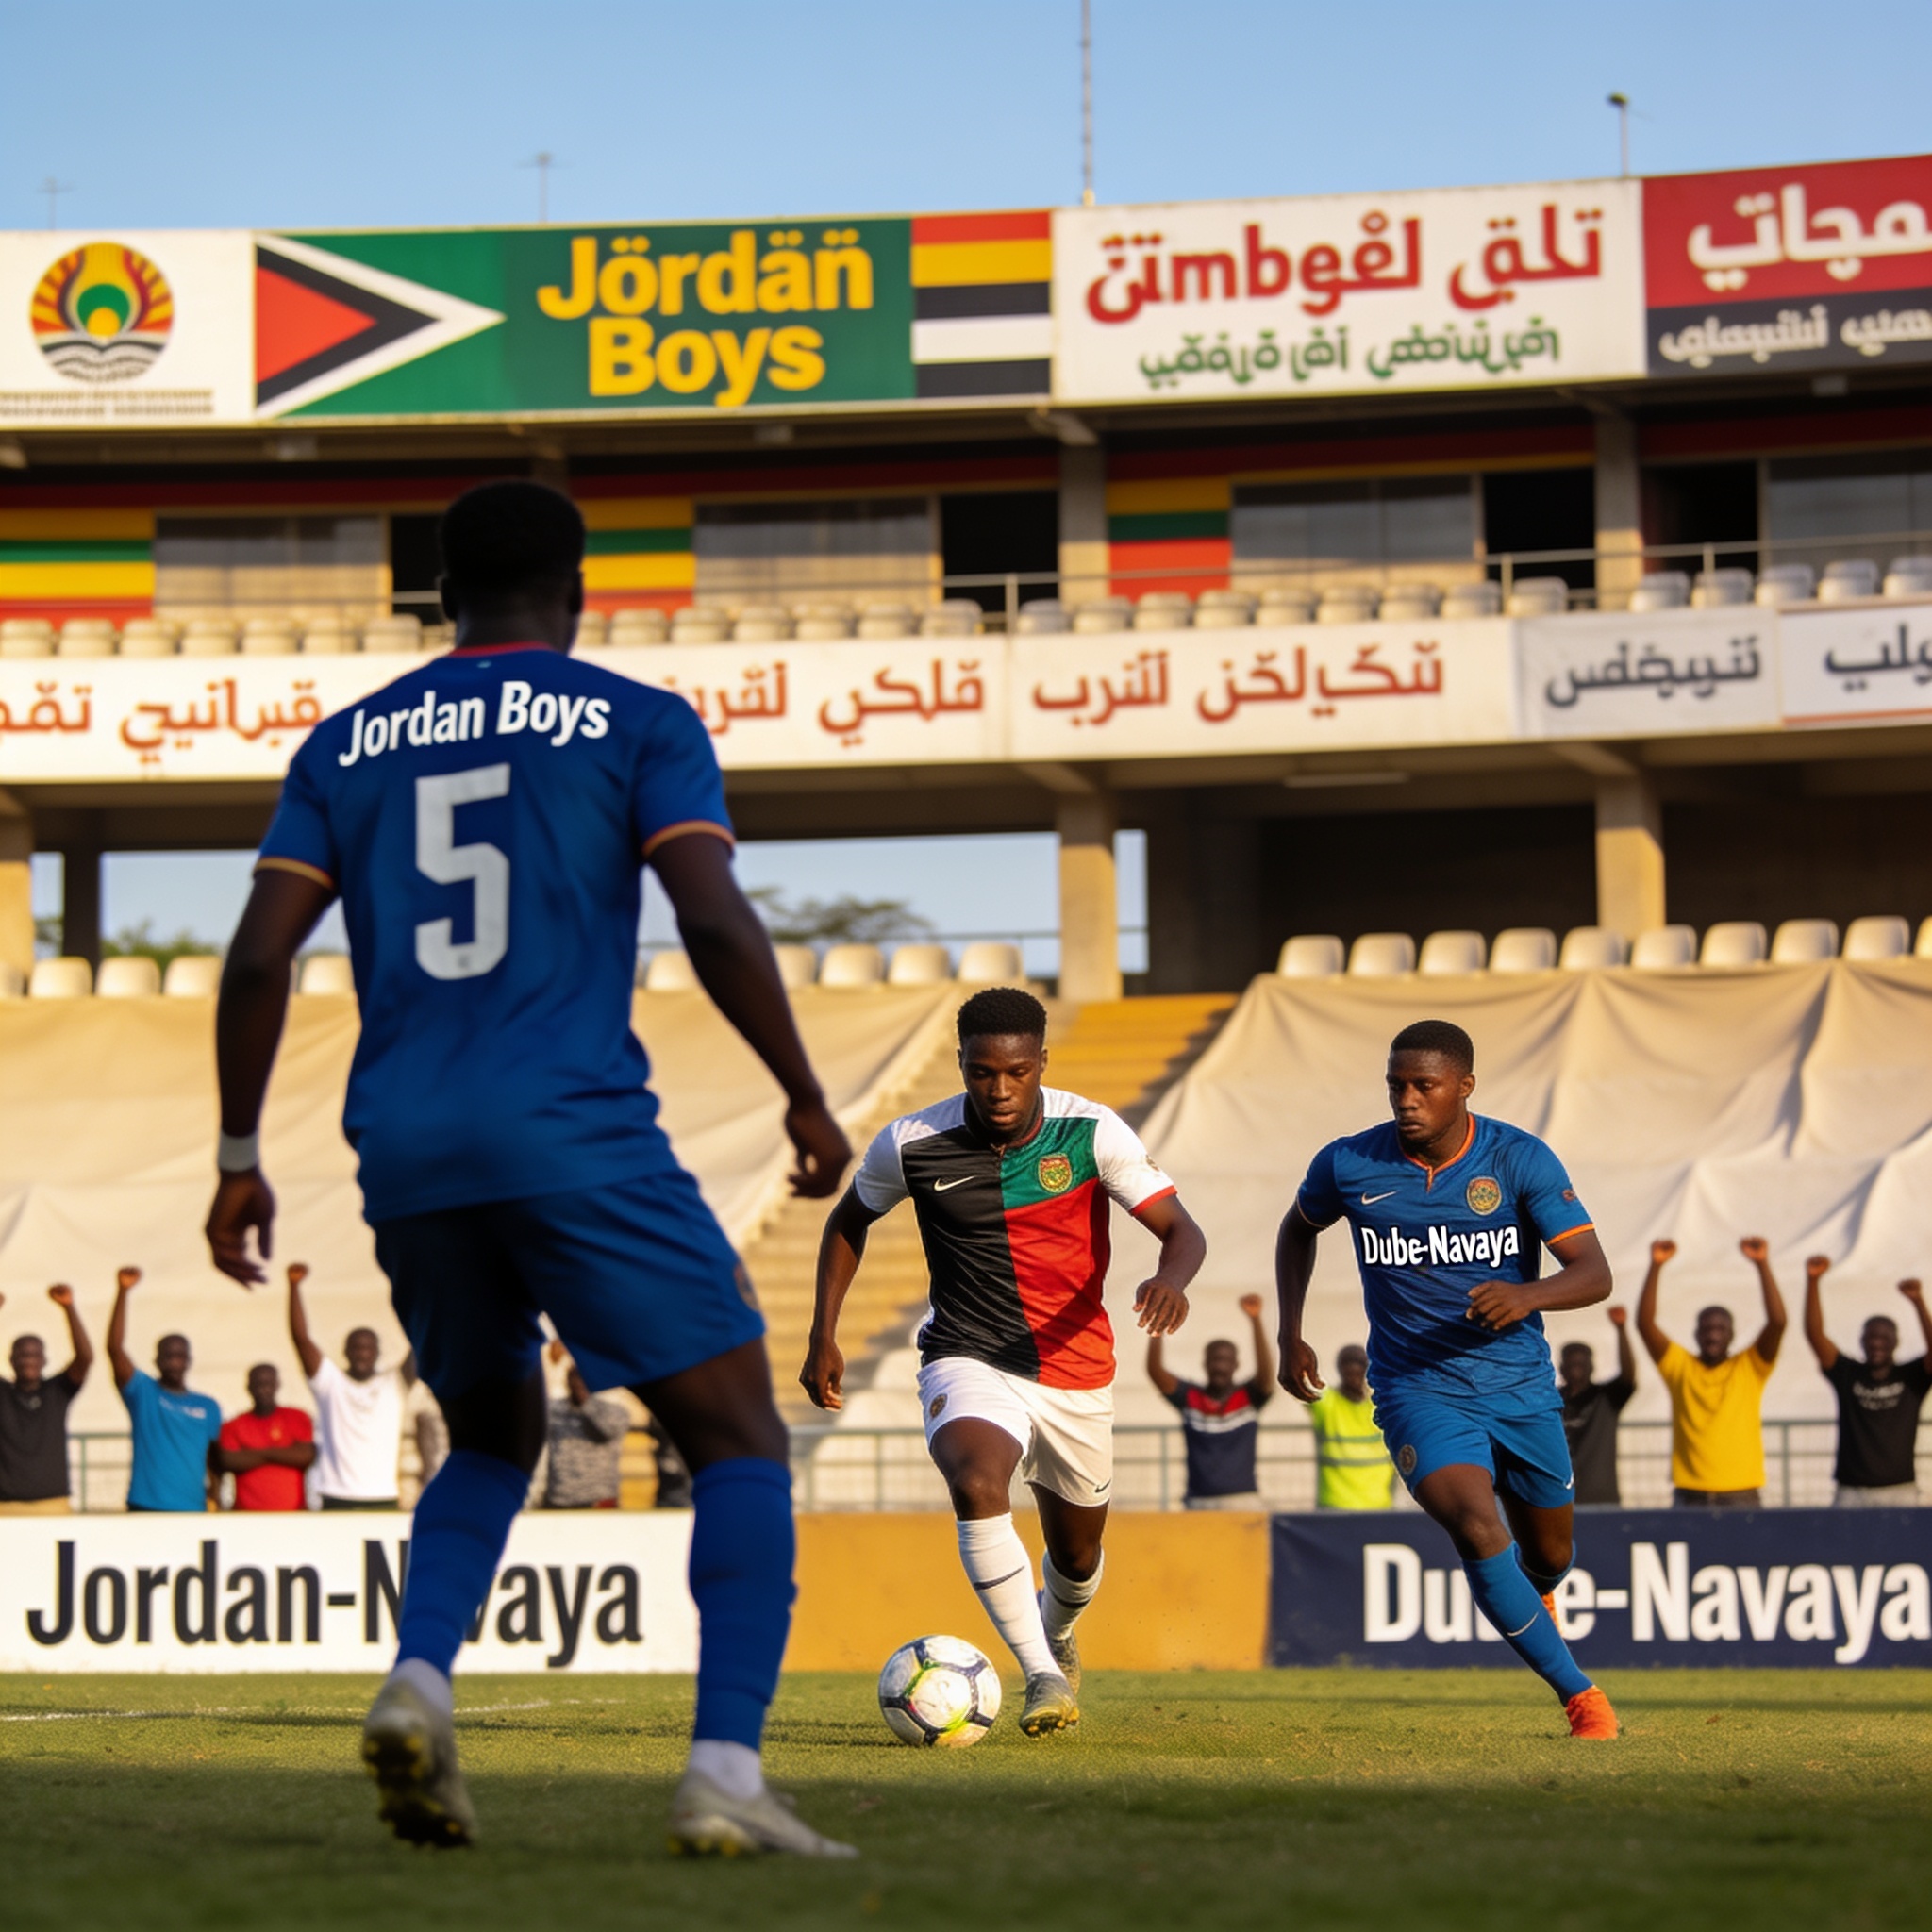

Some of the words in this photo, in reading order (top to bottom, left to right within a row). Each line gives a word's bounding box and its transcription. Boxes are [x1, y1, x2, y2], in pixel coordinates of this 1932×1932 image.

[589, 315, 826, 408] Boys
[338, 690, 486, 767] Jordan
[496, 681, 612, 747] Boys
[415, 762, 511, 980] 5
[1360, 1225, 1520, 1268] Dube-Navaya
[26, 1540, 644, 1669] Jordan-Naya
[1363, 1541, 1932, 1665] Due-Navaya
